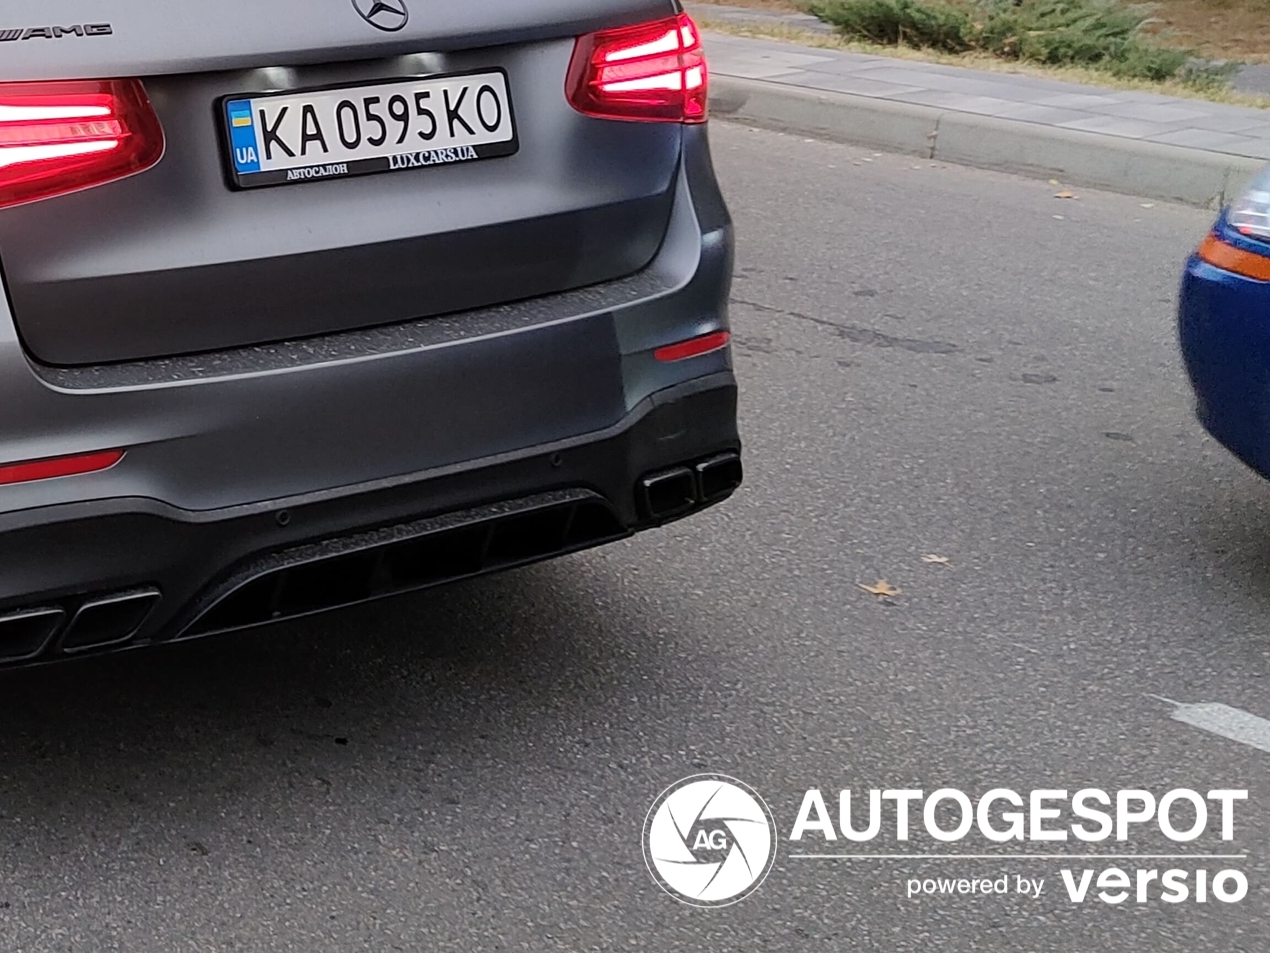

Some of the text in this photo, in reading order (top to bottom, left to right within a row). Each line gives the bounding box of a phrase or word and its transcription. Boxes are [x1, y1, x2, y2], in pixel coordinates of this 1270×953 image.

[21, 24, 112, 40] AMG
[258, 103, 329, 160] KA
[335, 91, 437, 149] 0595
[236, 146, 257, 164] UA
[286, 163, 348, 181] АВТОСАЛОН
